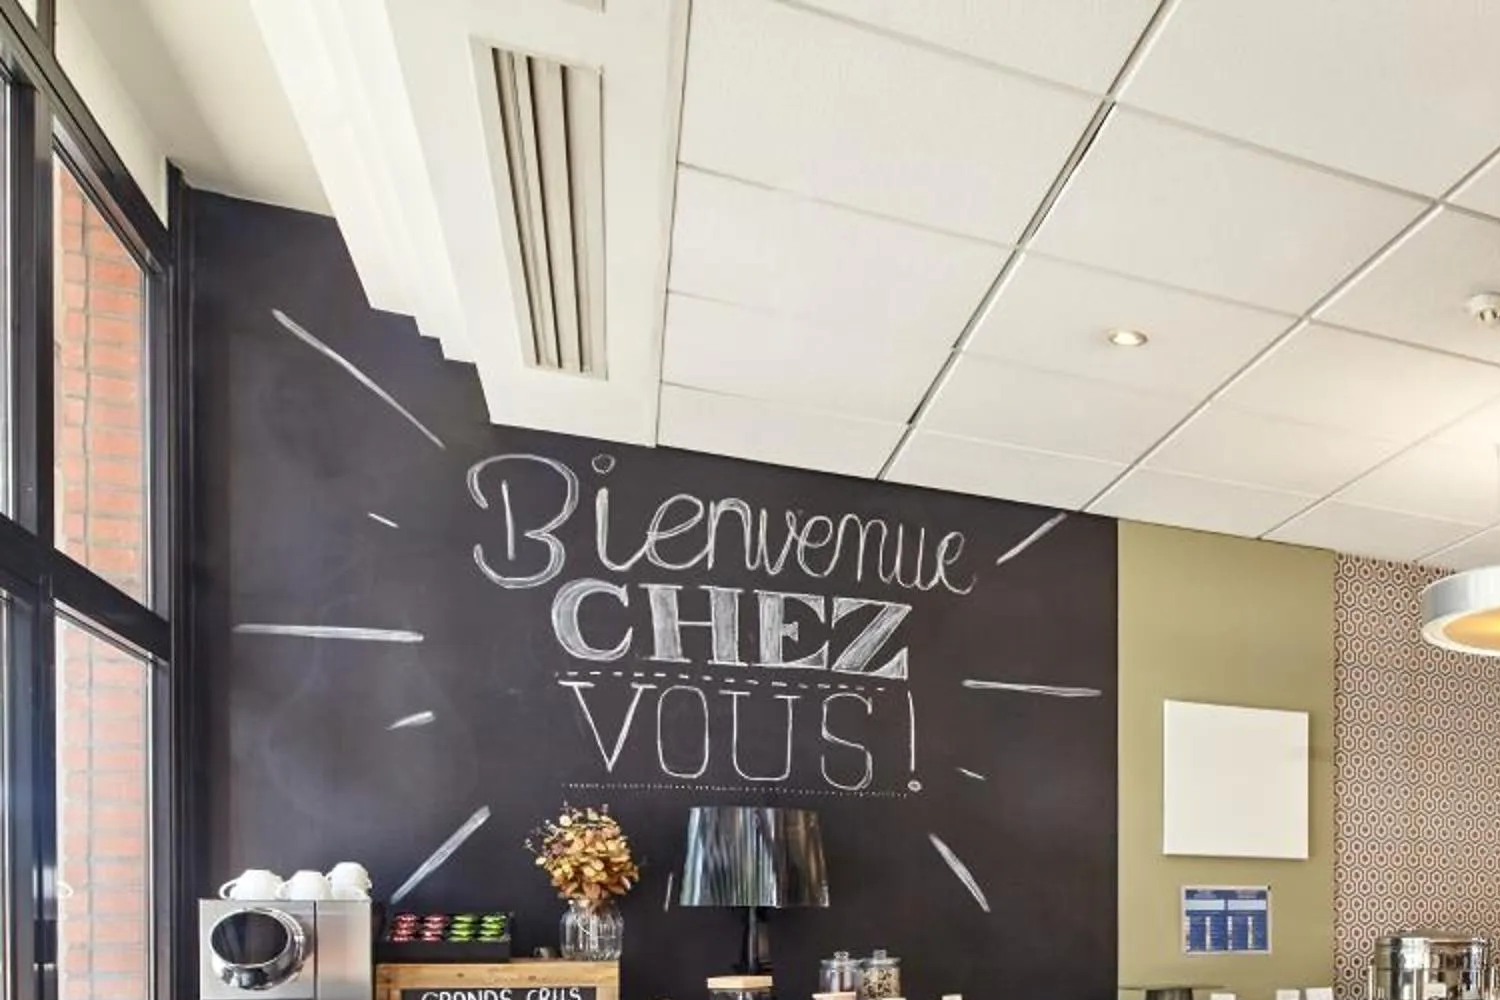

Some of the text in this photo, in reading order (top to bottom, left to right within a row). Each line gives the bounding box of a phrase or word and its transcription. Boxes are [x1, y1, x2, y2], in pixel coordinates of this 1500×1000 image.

[467, 453, 977, 594] Bienvenue
[551, 577, 913, 679] CHEZ
[558, 679, 923, 792] VOUS!
